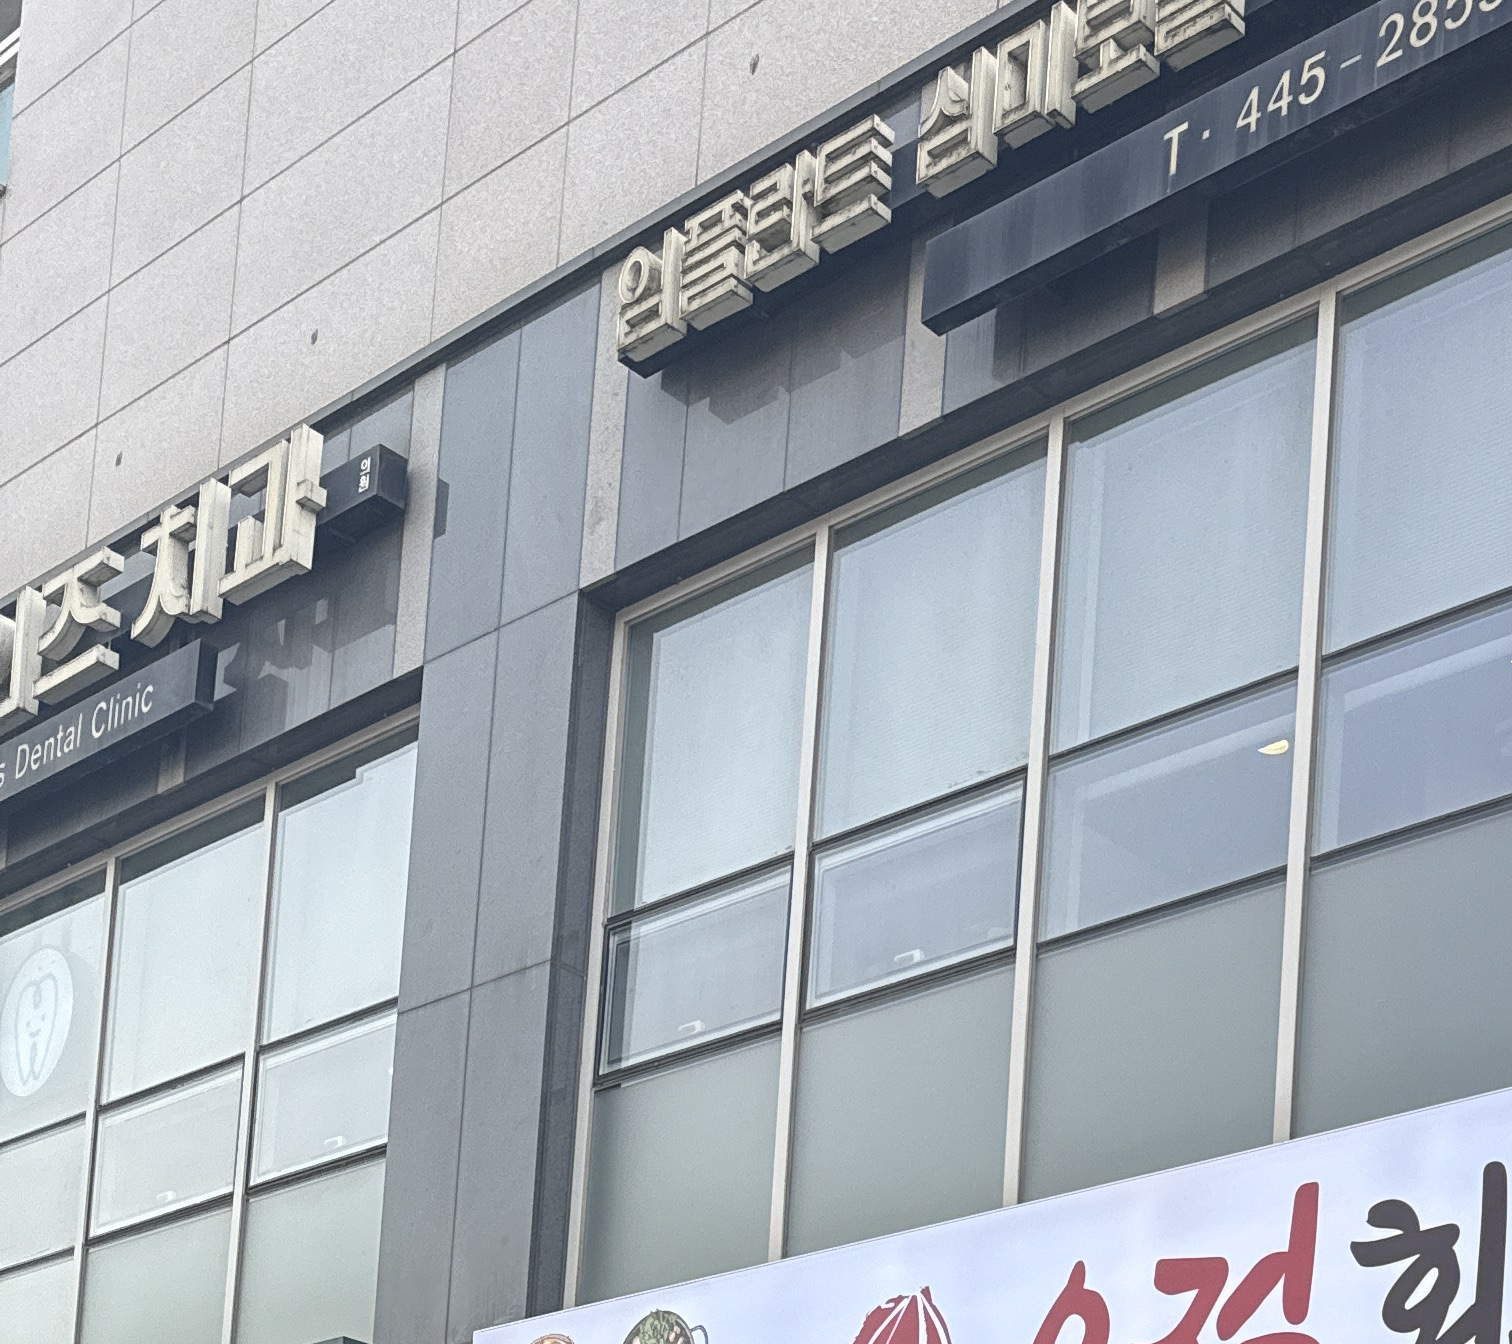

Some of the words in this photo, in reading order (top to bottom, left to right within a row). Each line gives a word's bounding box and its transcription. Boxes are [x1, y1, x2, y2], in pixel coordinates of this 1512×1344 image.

[617, 113, 895, 368] 임플란트
[15, 713, 83, 781] Dental
[91, 682, 154, 740] Clinic
